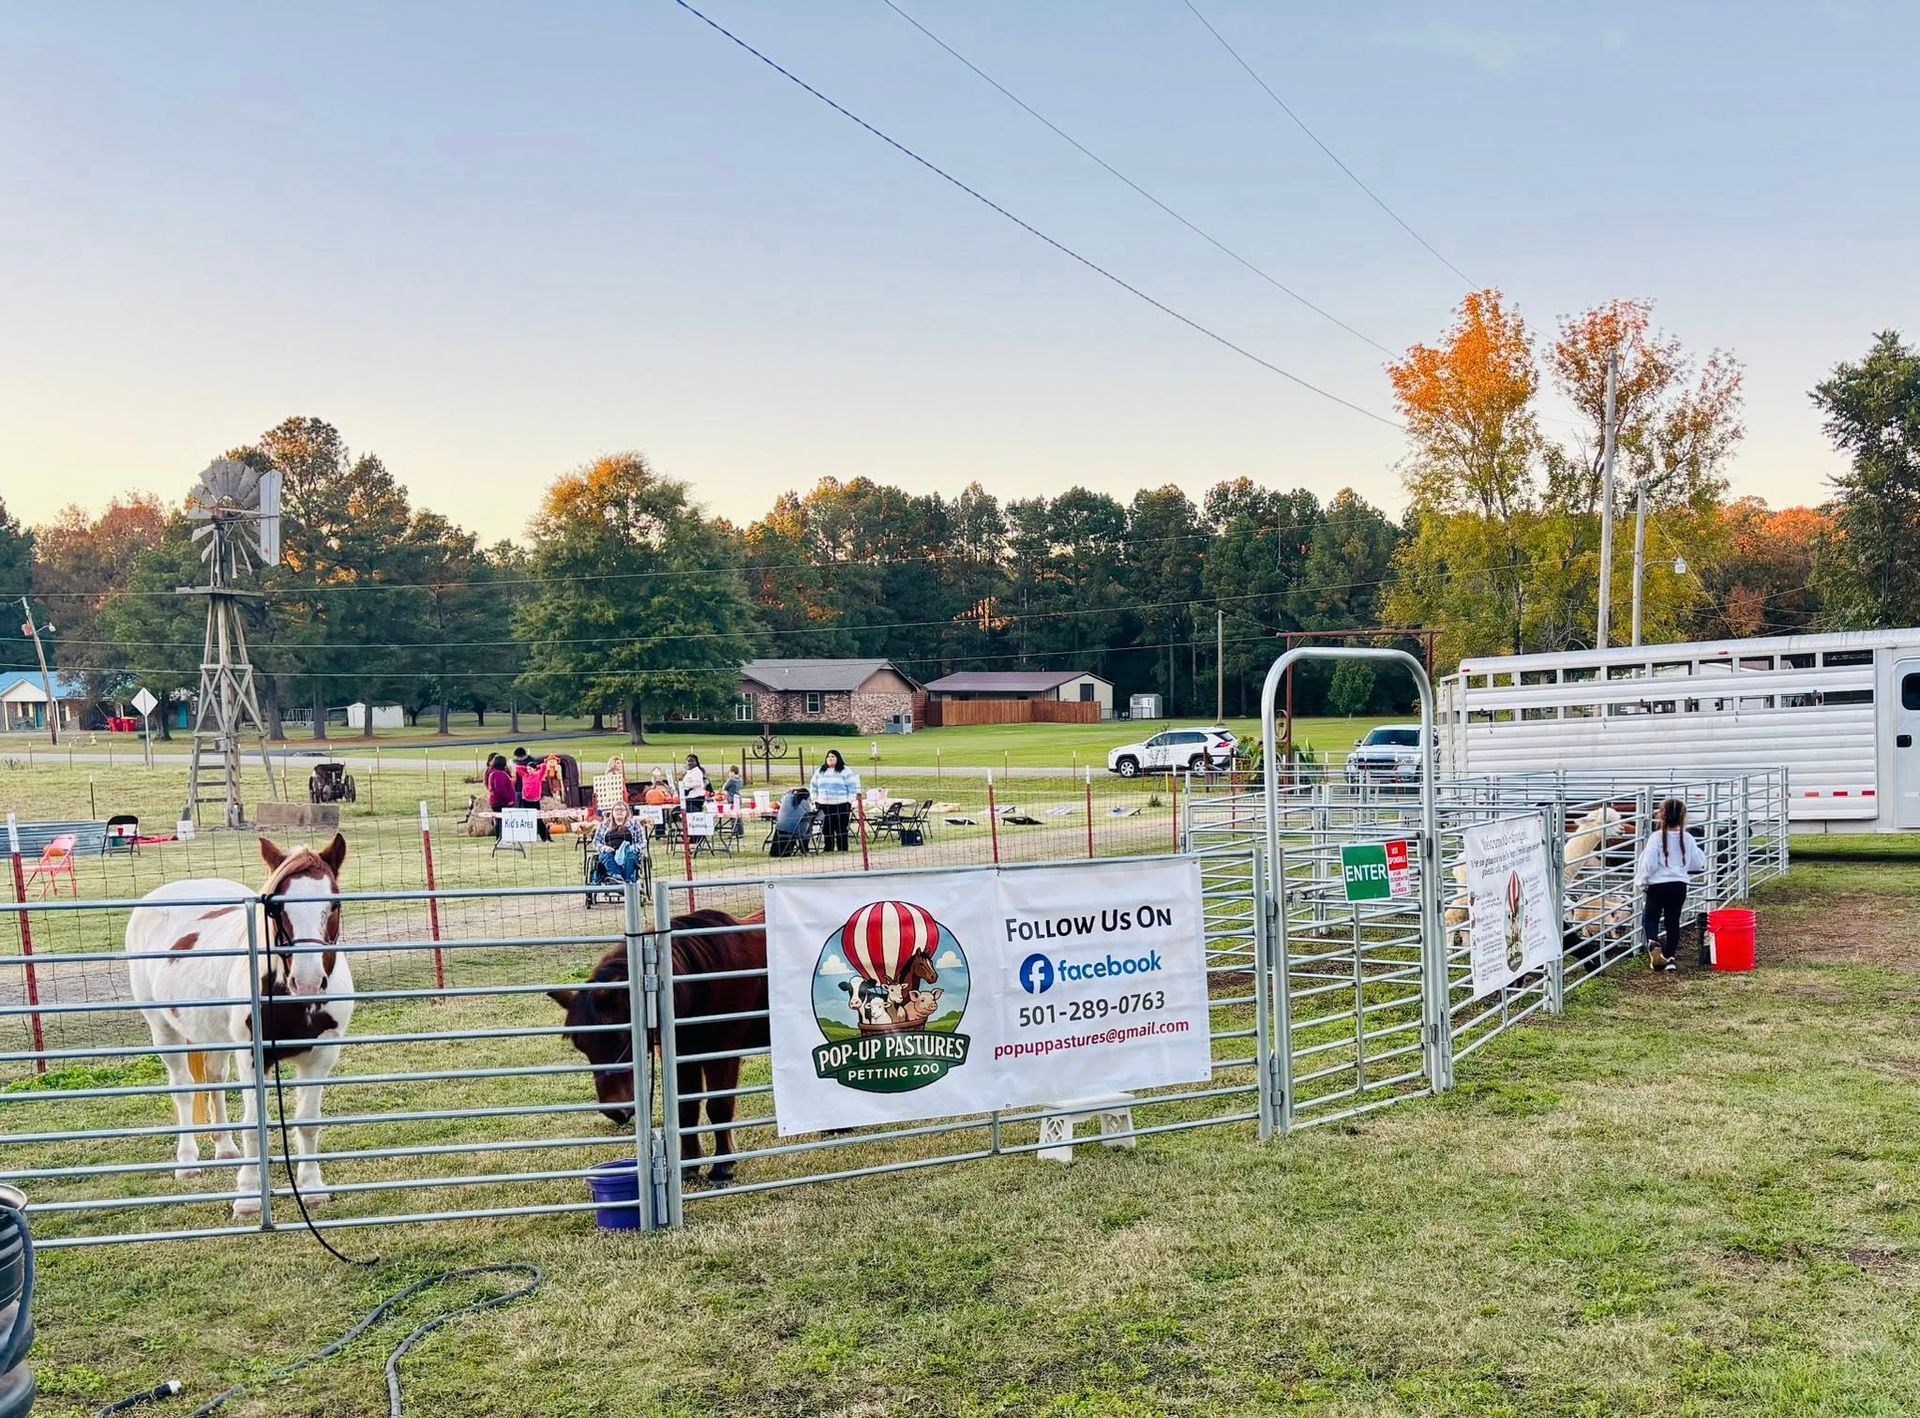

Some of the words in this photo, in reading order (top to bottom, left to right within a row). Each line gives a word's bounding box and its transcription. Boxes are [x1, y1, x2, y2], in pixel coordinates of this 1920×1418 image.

[504, 818, 519, 829] Kid's
[520, 818, 534, 829] Area
[1345, 863, 1388, 882] ENTER
[1058, 949, 1162, 982] facebook
[1019, 990, 1166, 1028] 501-289-0763
[818, 1038, 882, 1072] POP-UP
[885, 1034, 965, 1060] PASTURES
[994, 1019, 1190, 1060] popuppastures@gmail.com
[848, 1066, 909, 1081] PETTING
[913, 1062, 940, 1076] ZOO
